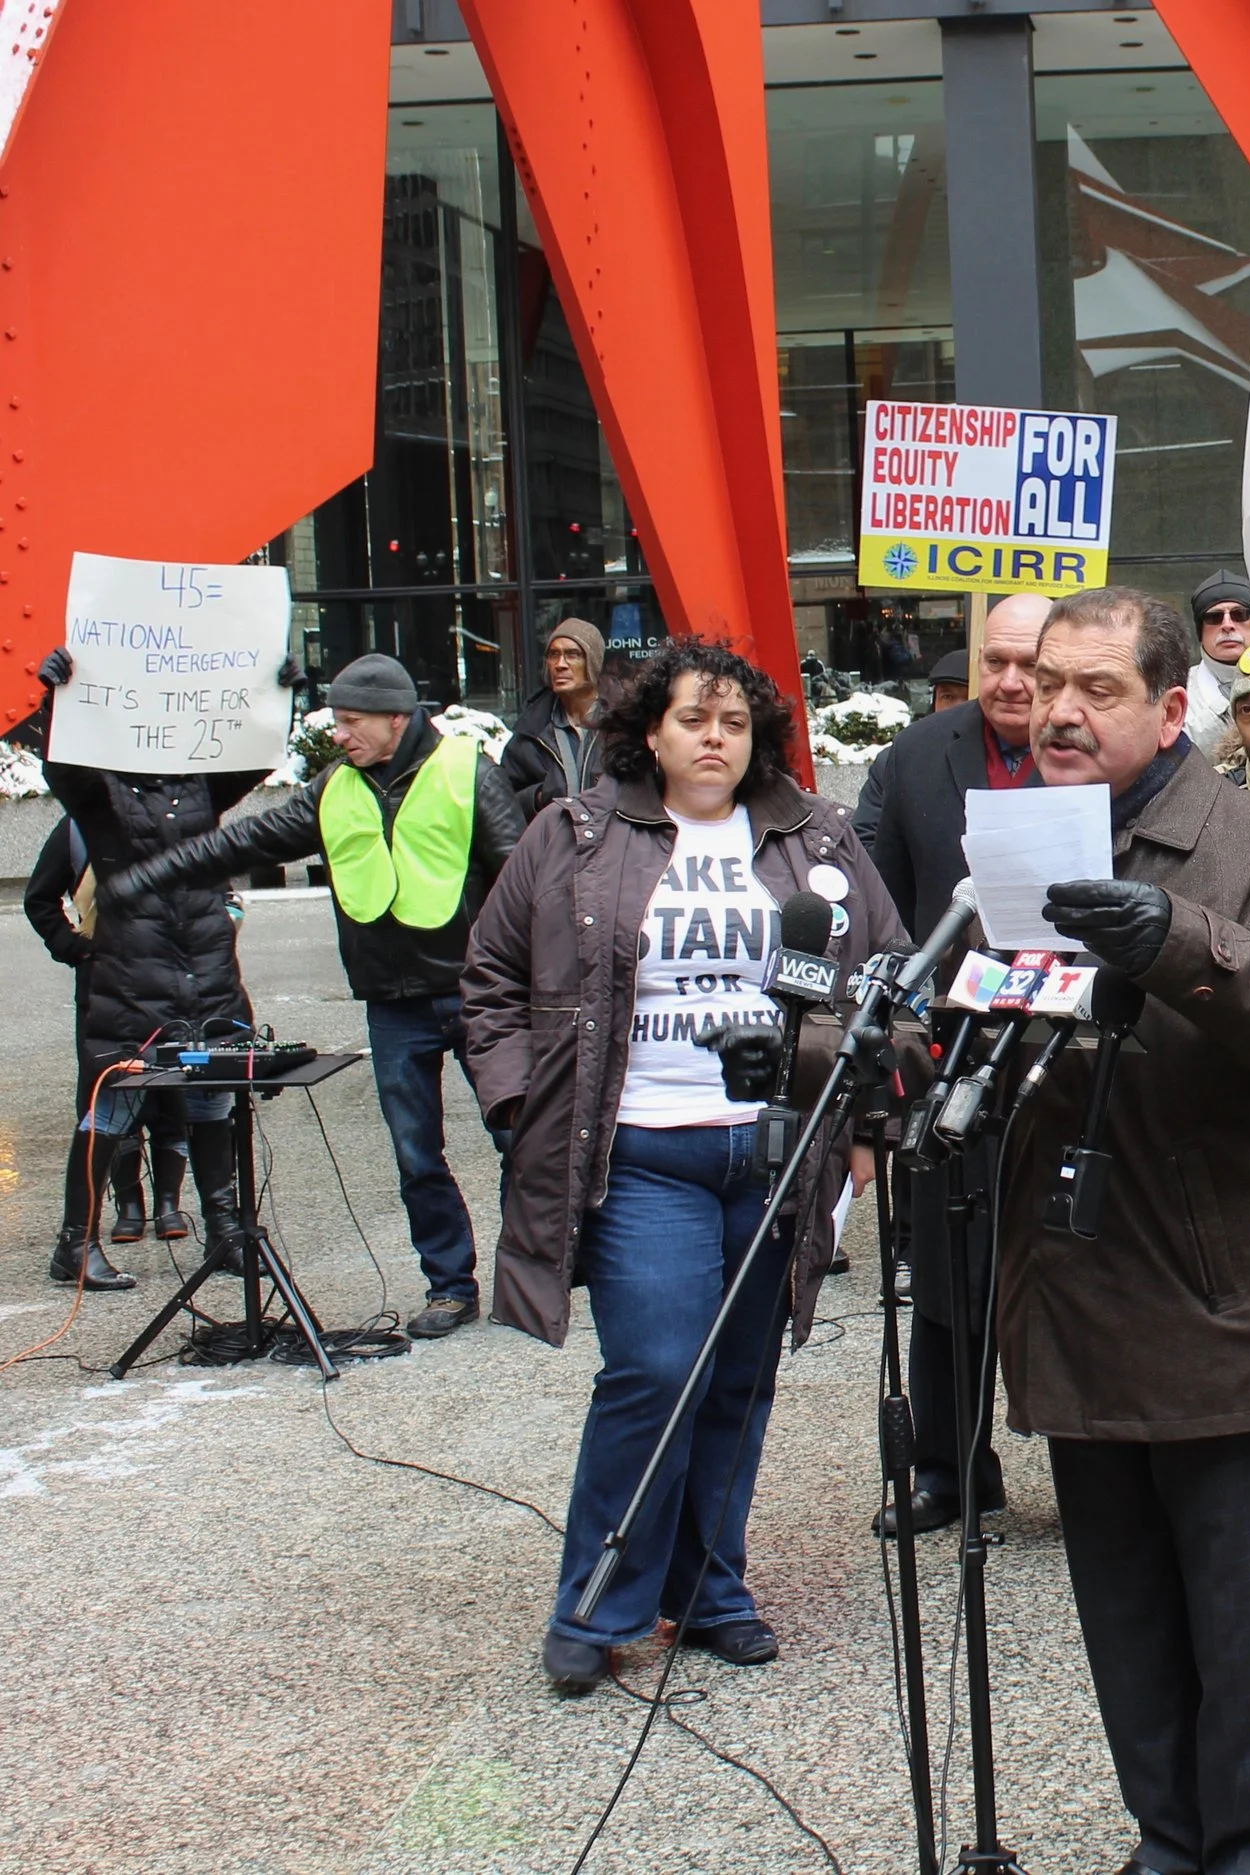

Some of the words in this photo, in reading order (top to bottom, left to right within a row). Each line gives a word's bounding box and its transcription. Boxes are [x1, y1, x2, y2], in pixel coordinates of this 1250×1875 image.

[875, 403, 1017, 448] CITIZENSHIP
[1021, 416, 1101, 477] FOR
[872, 447, 959, 487] EQUITY
[870, 492, 1011, 536] LIBERATION
[1018, 477, 1098, 539] ALL
[928, 543, 1087, 583] ICIRR
[161, 565, 223, 608] 45=
[70, 617, 193, 650] NATIONAL
[605, 637, 642, 649] JOHN
[145, 650, 260, 673] EMERGENCY
[78, 681, 139, 710] IT'S
[159, 689, 211, 712] TIME
[221, 688, 251, 711] FOR
[130, 725, 177, 749] THE
[660, 855, 748, 892] AKE
[782, 955, 836, 987] WGN
[1016, 953, 1045, 966] FOX
[675, 974, 743, 995] FOR
[1000, 970, 1036, 996] 32
